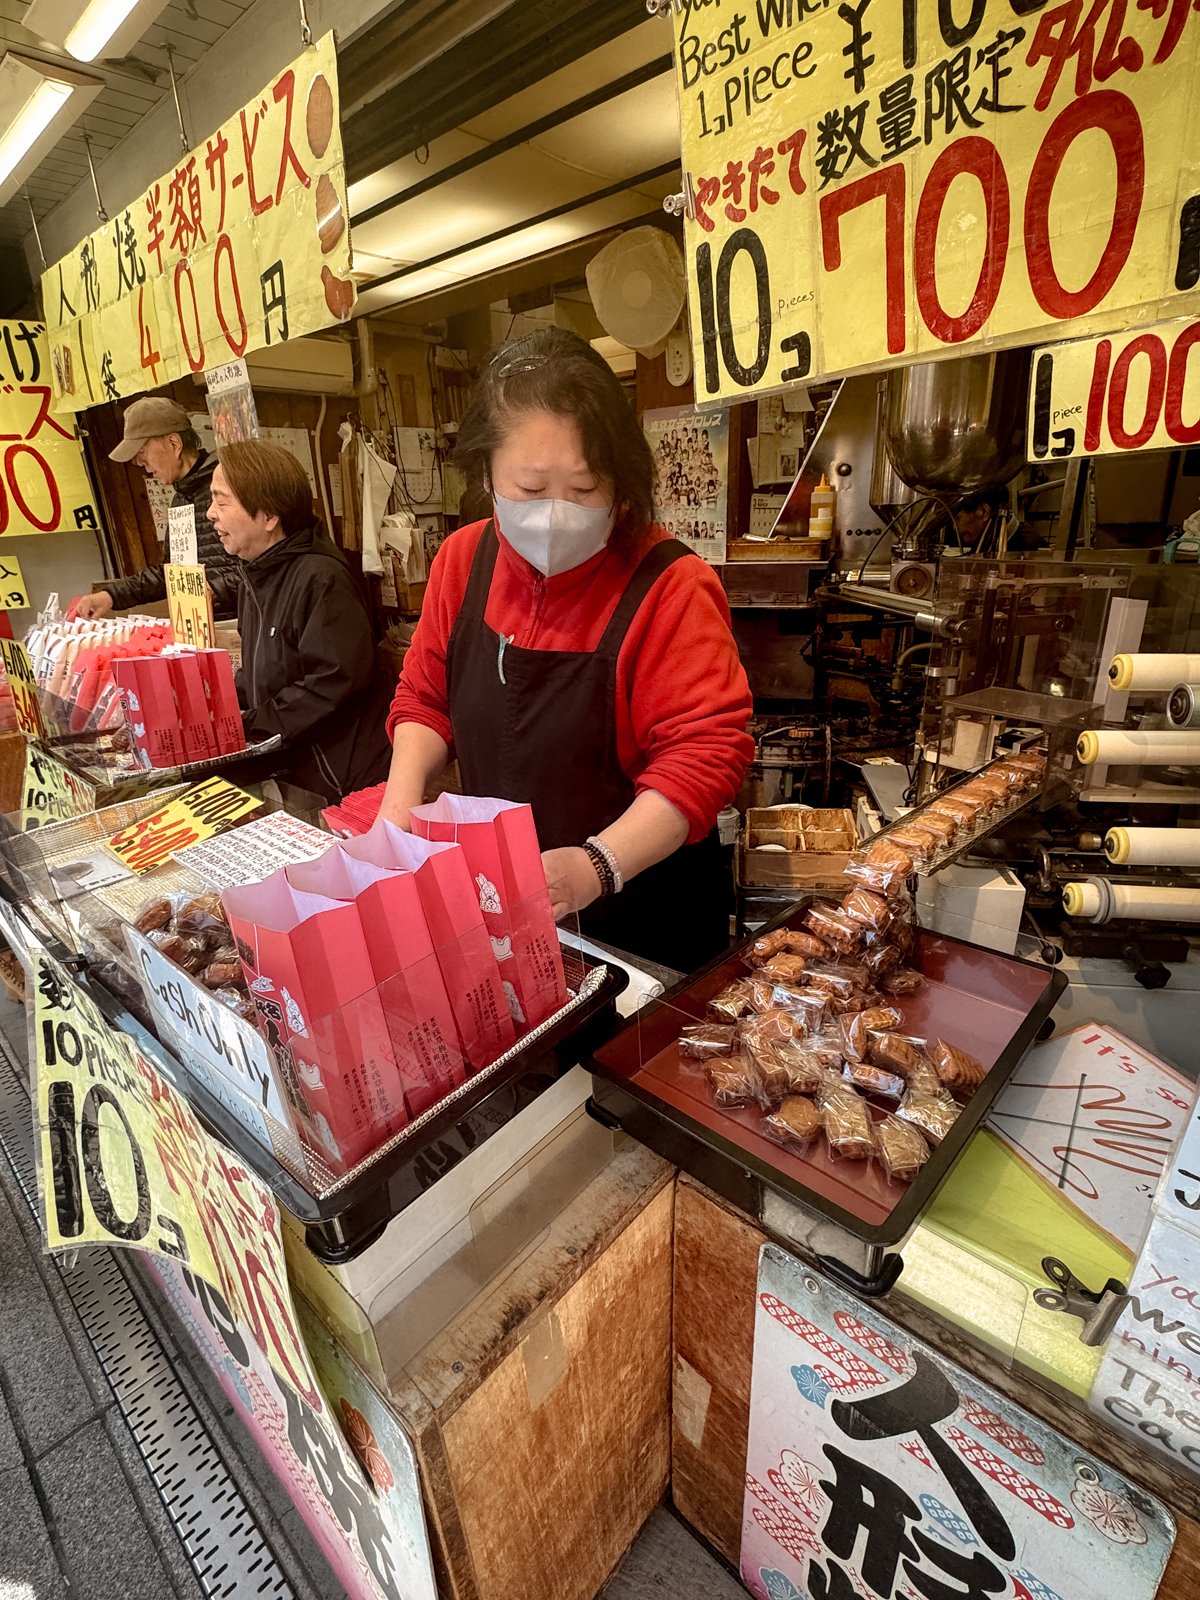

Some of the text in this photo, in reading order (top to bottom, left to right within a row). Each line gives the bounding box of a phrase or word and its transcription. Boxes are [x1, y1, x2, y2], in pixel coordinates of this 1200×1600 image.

[680, 13, 751, 90] Best
[815, 0, 1200, 190] 数量限定 タイムサ
[691, 128, 808, 233] やきたて
[776, 290, 816, 320] pieces
[819, 89, 1200, 355] 700
[57, 210, 146, 327] 人形焼
[0, 322, 46, 383] げ
[1052, 404, 1083, 426] piece
[0, 443, 99, 535] 0円
[169, 569, 205, 597] 賞味期限
[140, 948, 270, 1109] Cash Only
[1082, 1033, 1190, 1111] It's So
[803, 1350, 1016, 1600] 人形
